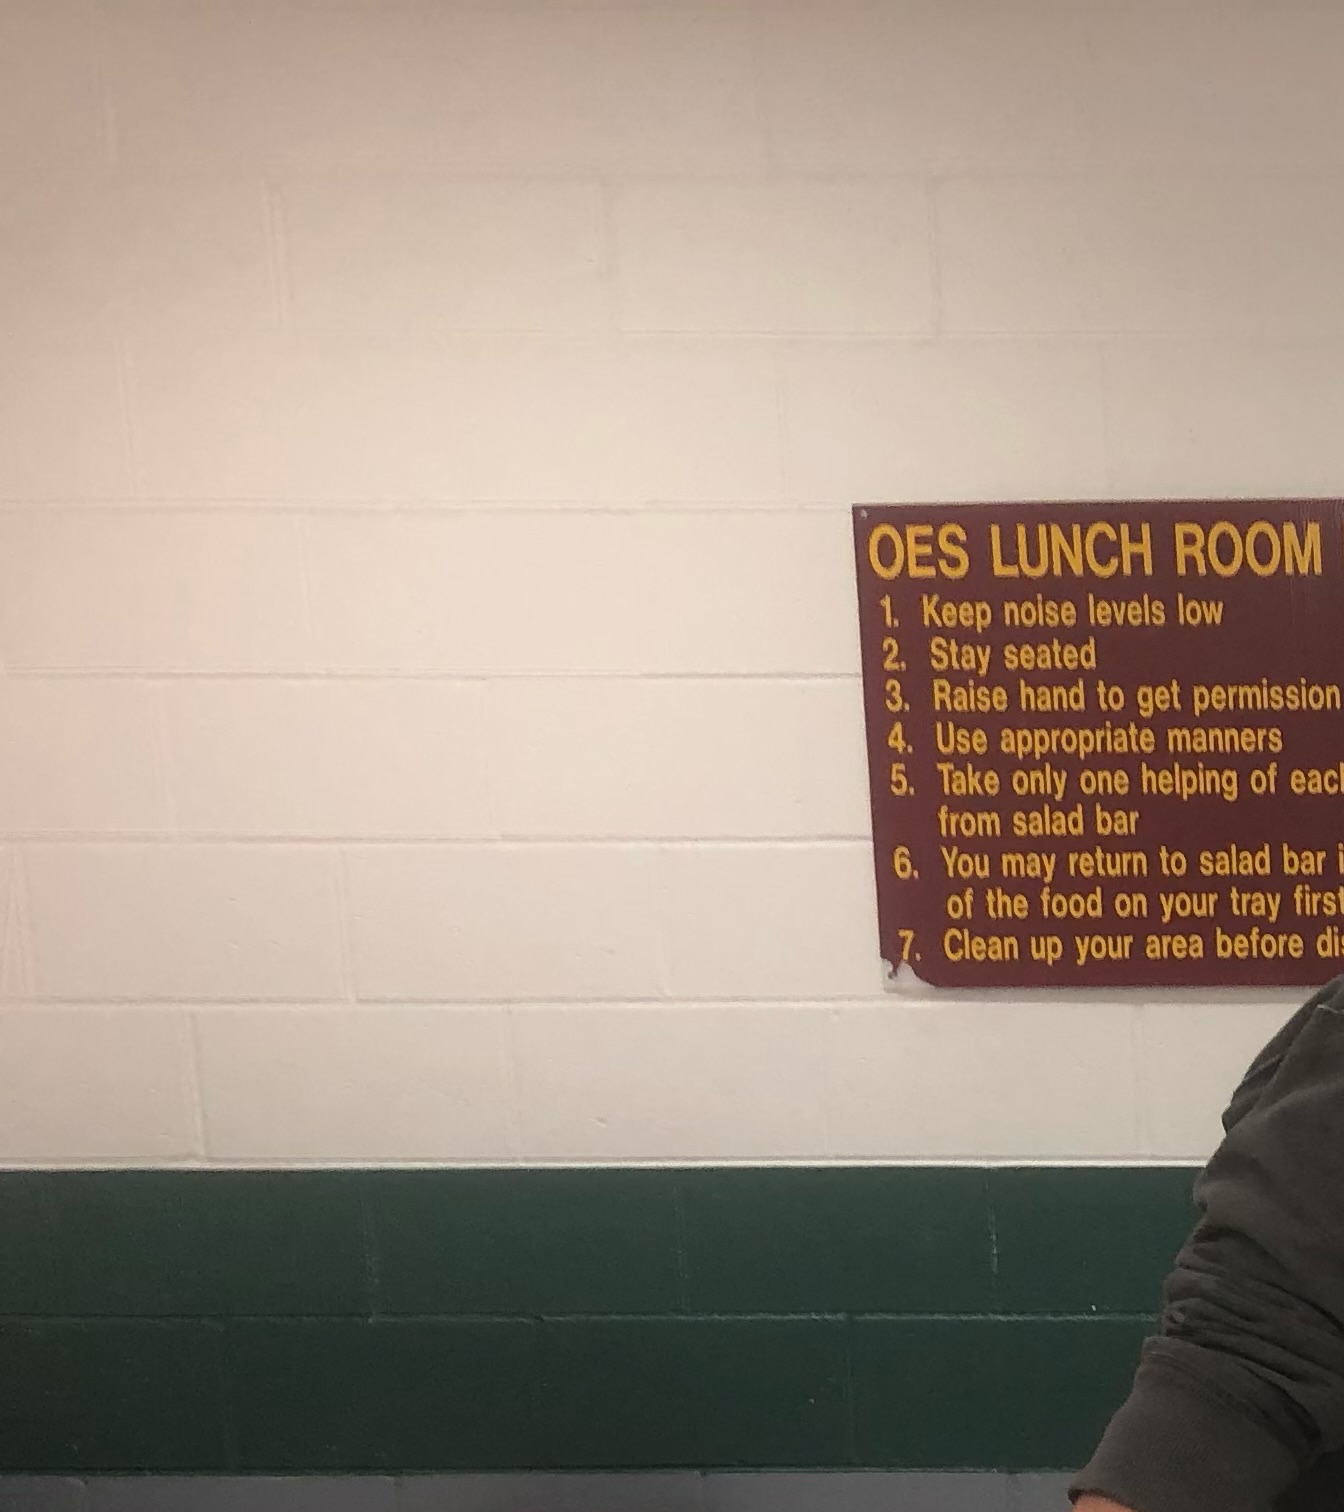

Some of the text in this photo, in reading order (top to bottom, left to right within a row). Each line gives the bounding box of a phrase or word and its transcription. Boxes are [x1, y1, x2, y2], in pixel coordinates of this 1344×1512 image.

[868, 521, 970, 581] OES
[990, 520, 1153, 580] LUNCH
[1174, 519, 1323, 578] ROOM
[879, 592, 1224, 634] 1. Keep noise levels low
[882, 635, 1097, 678] 2. Stay seated
[885, 677, 1342, 719] 3. Raise hand to get permission
[887, 720, 1283, 761] 4. Use appropriate manners
[890, 762, 915, 797] 5.
[936, 761, 1000, 797] Take
[1012, 761, 1068, 802] only
[1079, 769, 1130, 796] one
[1141, 761, 1238, 802] helping
[1250, 761, 1278, 795] of
[937, 801, 1140, 838] from salad bar
[893, 845, 919, 880] 6.
[940, 845, 990, 880] You
[1001, 852, 1057, 884] may
[1068, 845, 1148, 878] return
[1159, 845, 1187, 877] to
[1199, 843, 1271, 877] salad
[1282, 842, 1327, 876] bar
[946, 887, 974, 920] of
[985, 886, 1029, 920] the
[1039, 885, 1103, 919] food
[1114, 892, 1148, 918] on
[1159, 891, 1219, 924] your
[1229, 886, 1281, 923] tray
[897, 928, 922, 962] 7.
[943, 927, 1019, 962] Clean
[1030, 935, 1063, 967] up
[1074, 934, 1134, 967] your
[1145, 934, 1204, 960] area
[1215, 926, 1304, 959] before
